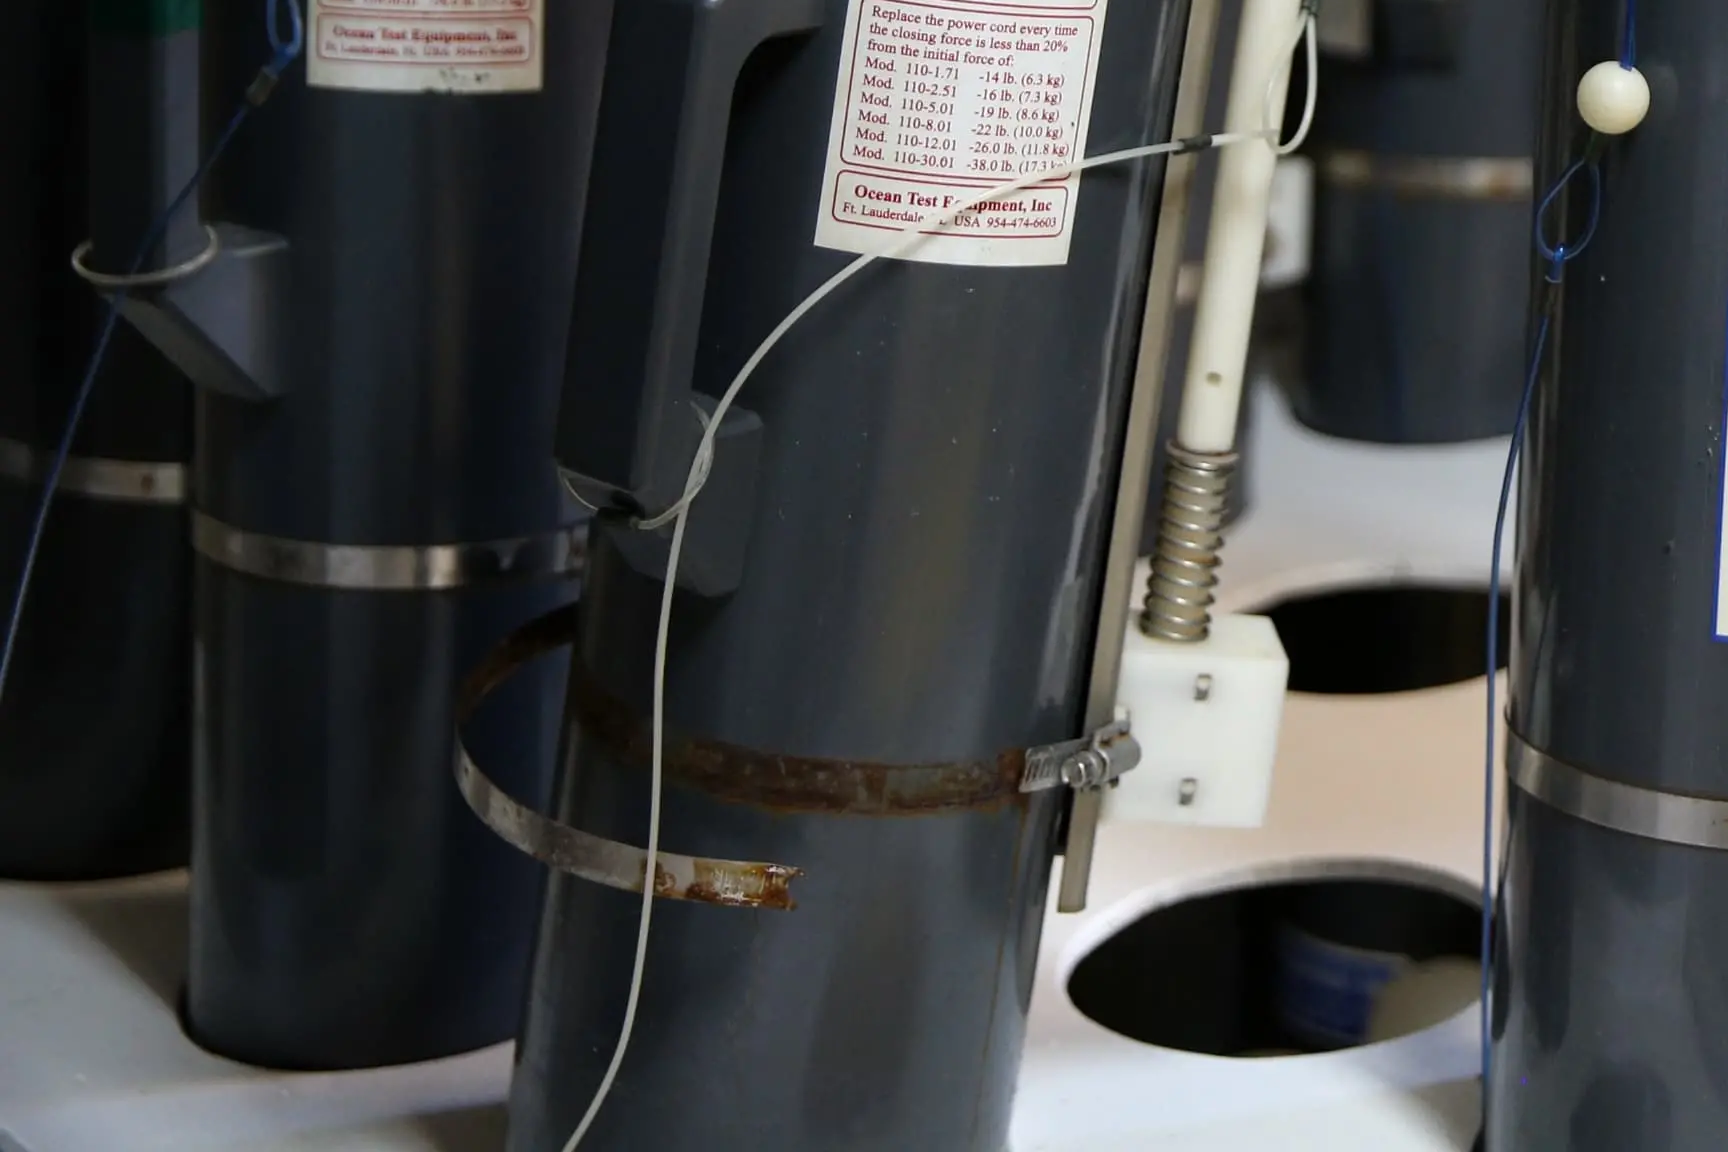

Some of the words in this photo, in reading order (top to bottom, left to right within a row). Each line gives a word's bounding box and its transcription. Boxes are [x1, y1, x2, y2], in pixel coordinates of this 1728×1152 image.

[870, 22, 888, 36] the
[892, 25, 937, 47] closing
[940, 31, 972, 47] force
[976, 34, 985, 48] is
[989, 36, 1012, 50] less
[1015, 39, 1040, 51] than
[1043, 39, 1067, 52] 20%
[872, 5, 921, 24] Replace
[924, 13, 944, 27] the
[948, 17, 985, 33] power
[989, 20, 1016, 34] cord
[1020, 25, 1051, 39] every
[1054, 24, 1078, 36] time
[867, 39, 898, 56] from
[901, 43, 919, 58] the
[924, 47, 959, 64] initial
[963, 50, 994, 65] force
[998, 54, 1014, 66] of:
[865, 56, 897, 73] Mod.
[906, 62, 959, 80] 110-1.71
[979, 71, 999, 84] -14
[1002, 72, 1017, 85] lb.
[1021, 73, 1043, 87] (6.3
[1047, 73, 1064, 90] kg)
[863, 75, 894, 90] Mod.
[904, 80, 957, 98] 110-2.51
[977, 89, 996, 101] -16
[1000, 90, 1015, 103] lb.
[1019, 90, 1041, 104] (7.3
[1044, 92, 1062, 107] kg)
[861, 92, 892, 108] Mod.
[901, 98, 955, 115] 110-5.01
[974, 106, 993, 119] -19
[997, 107, 1013, 120] lb.
[1016, 108, 1038, 122] (8.6
[1041, 110, 1059, 124] kg)
[858, 110, 890, 125] Mod.
[899, 115, 951, 133] 110-8.01
[971, 125, 991, 136] -22
[994, 125, 1009, 137] lb.
[1014, 125, 1043, 140] (10.0
[1046, 126, 1063, 141] kg)
[856, 127, 888, 143] Mod.
[897, 133, 957, 151] 110-12.01
[969, 142, 1000, 154] -26.0
[1004, 142, 1018, 155] lb.
[1021, 143, 1049, 157] (11.8
[1052, 143, 1069, 157] kg)
[853, 145, 885, 161] Mod.
[894, 151, 954, 169] 110-30.01
[967, 160, 997, 172] -38.0
[1000, 160, 1015, 172] lb.
[855, 185, 901, 204] Ocean
[907, 192, 937, 208] Test
[1032, 199, 1051, 211] Inc
[843, 202, 858, 214] Ft.
[954, 215, 980, 227] USA
[987, 217, 1056, 228] 954-474-6603
